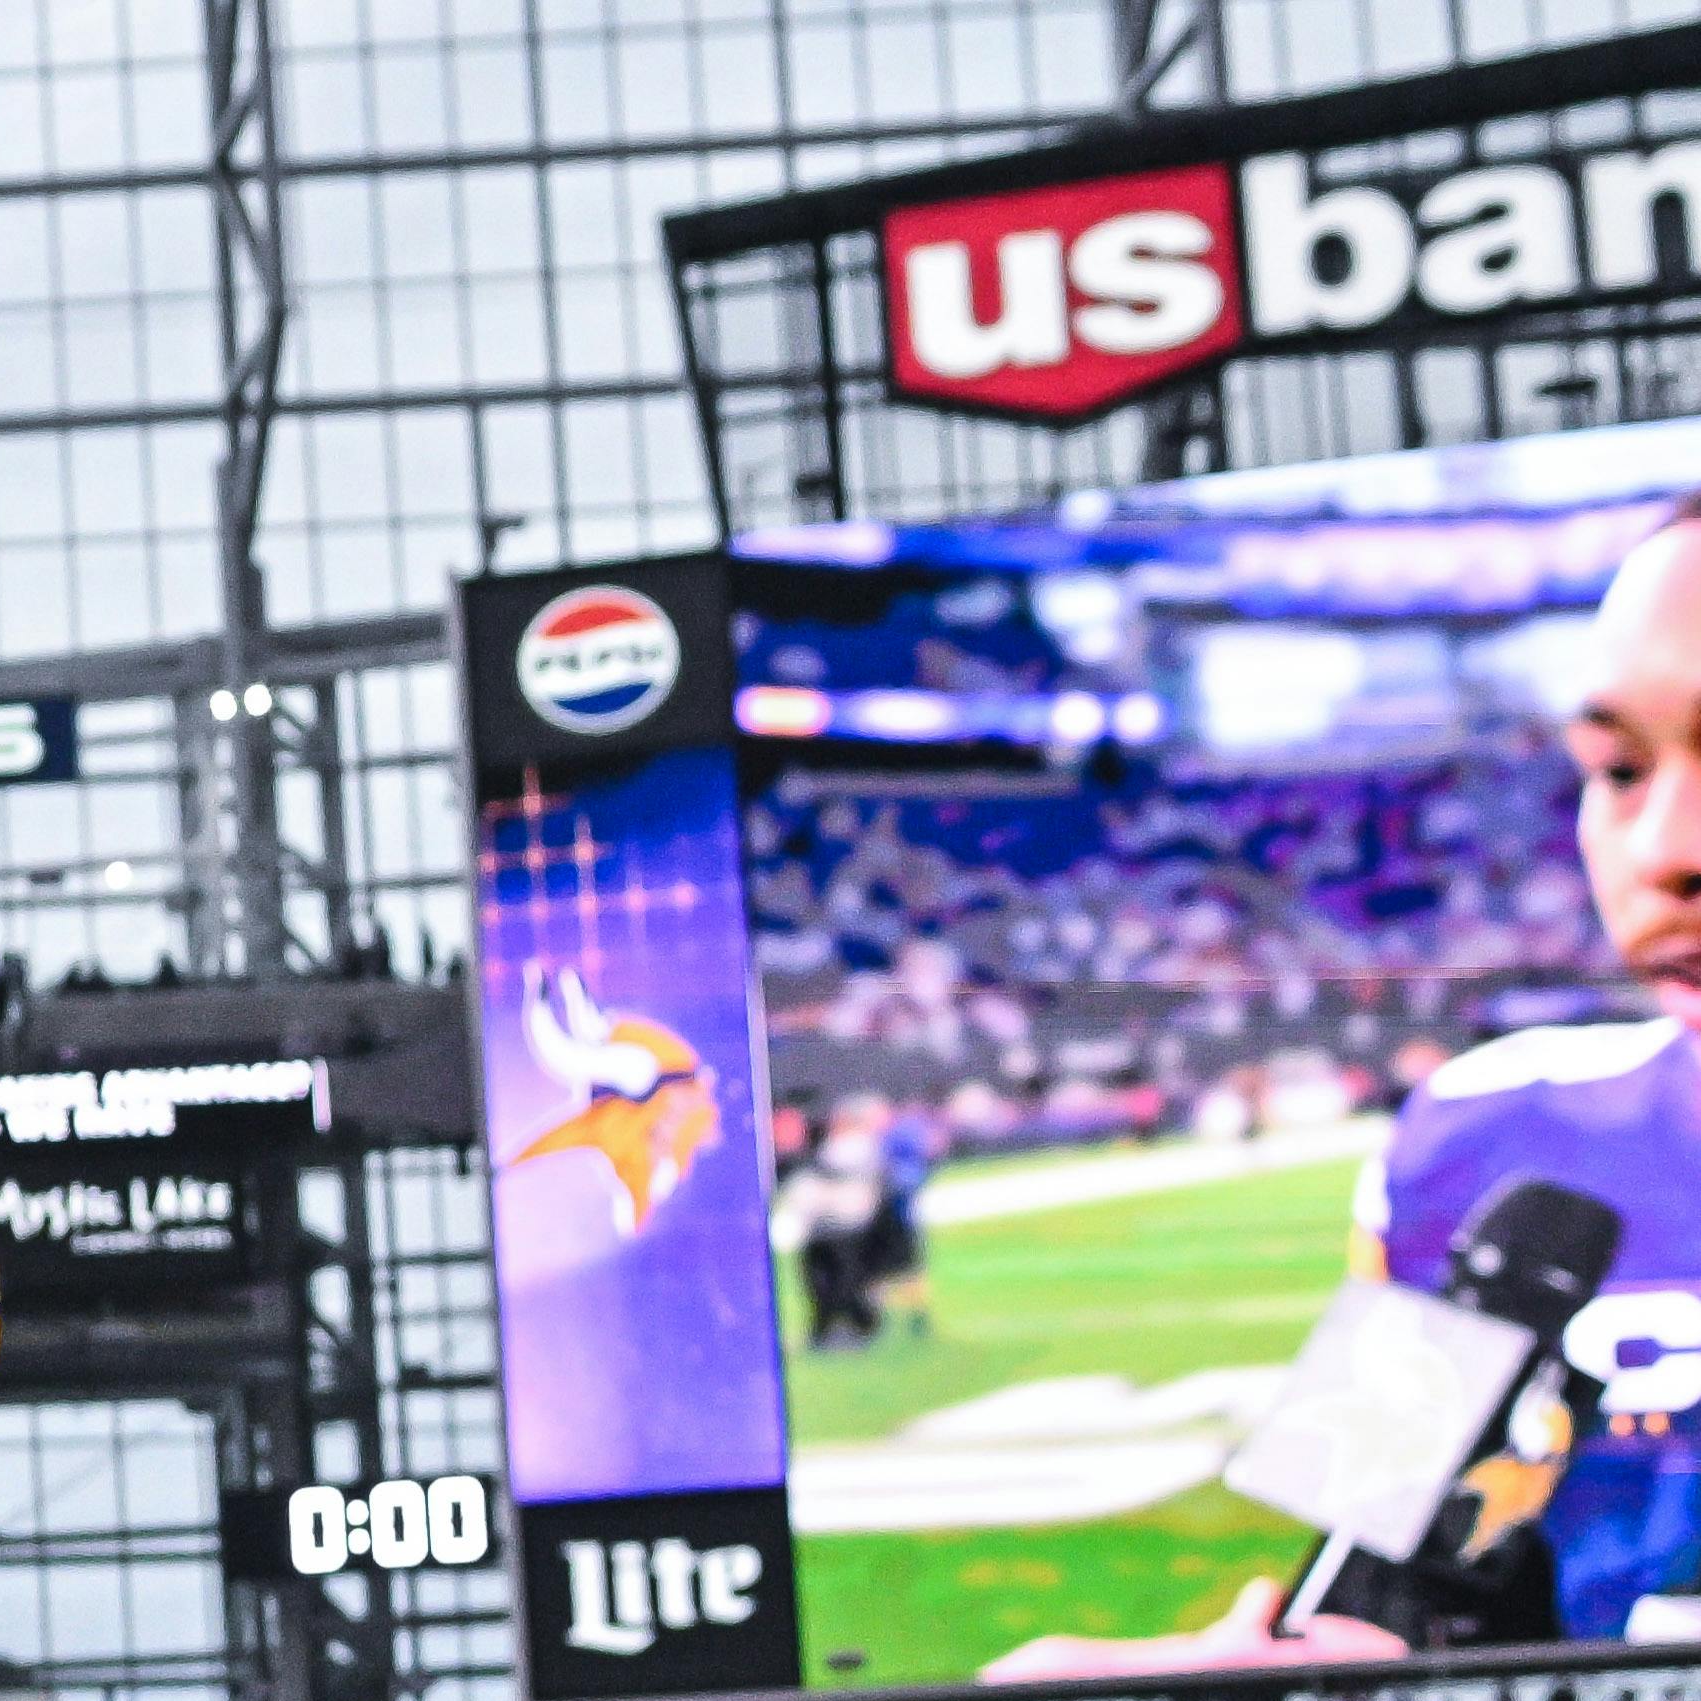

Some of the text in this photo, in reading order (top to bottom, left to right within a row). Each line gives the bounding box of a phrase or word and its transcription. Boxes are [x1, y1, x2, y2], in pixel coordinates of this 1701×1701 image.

[904, 140, 1701, 378] us ban
[288, 1474, 489, 1575] 0:00
[561, 1536, 763, 1656] Lite
